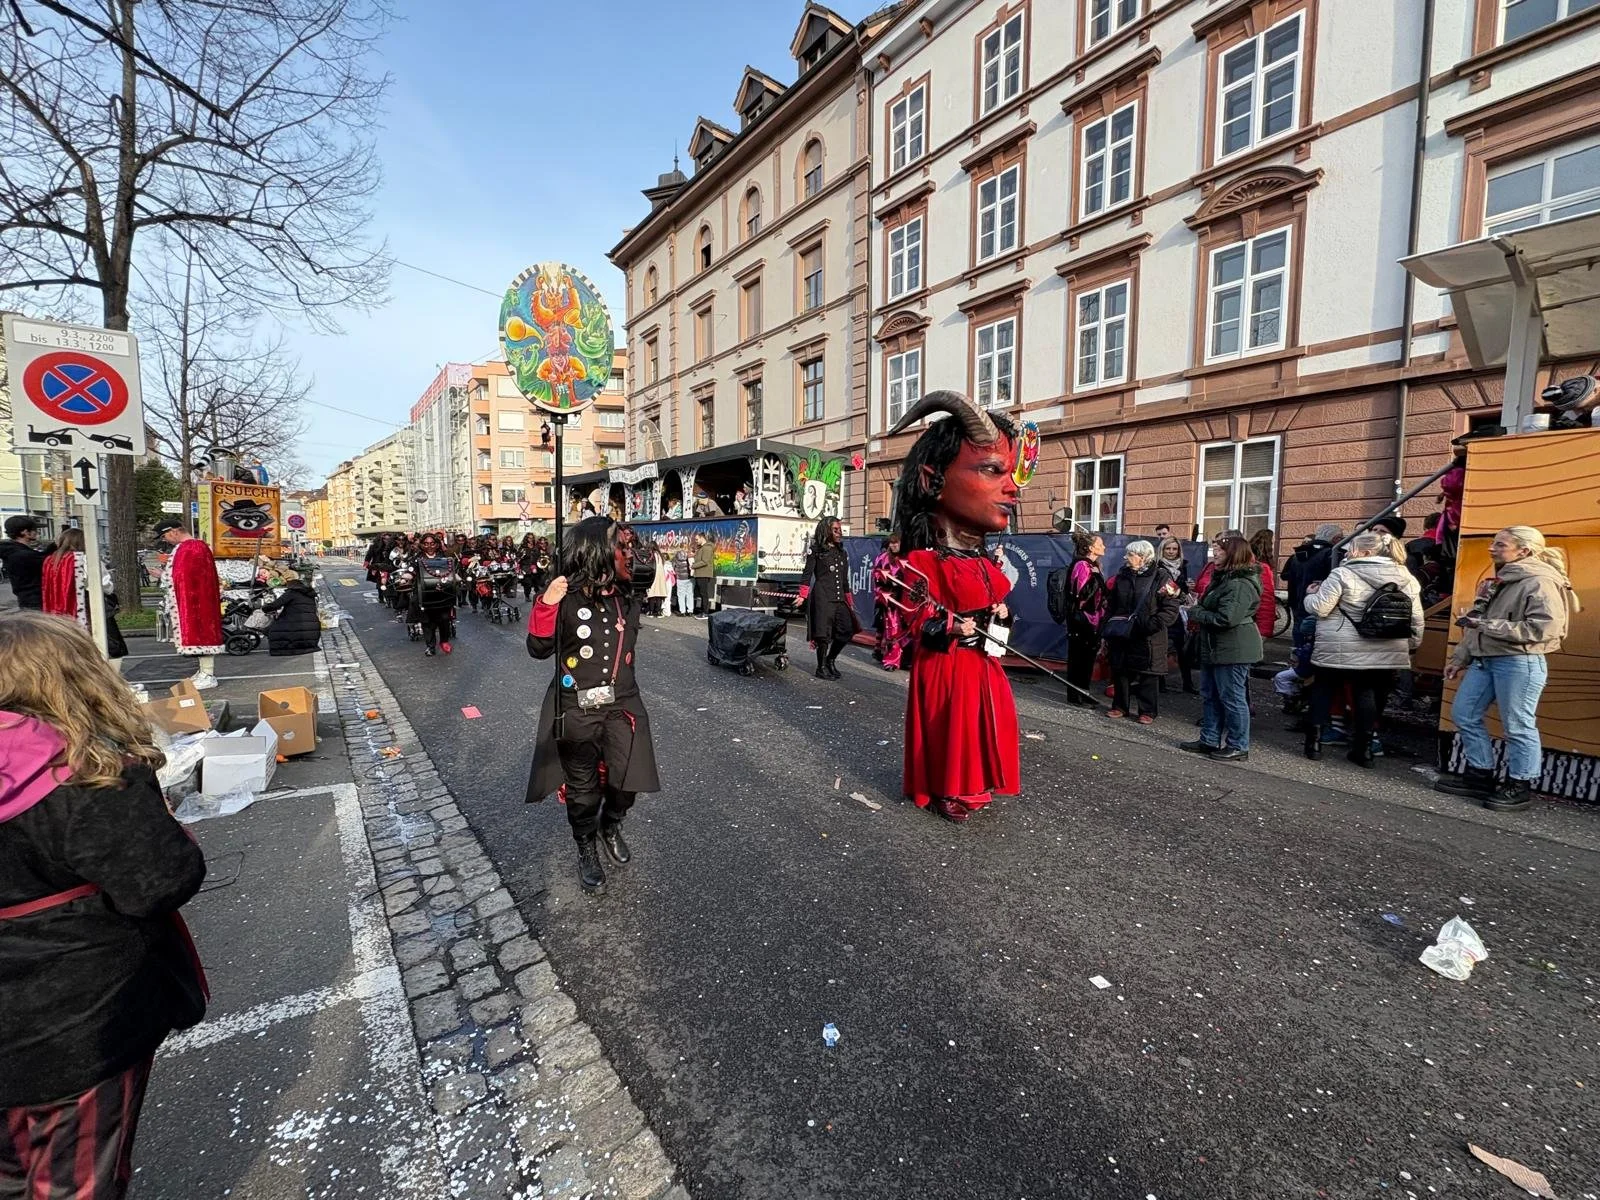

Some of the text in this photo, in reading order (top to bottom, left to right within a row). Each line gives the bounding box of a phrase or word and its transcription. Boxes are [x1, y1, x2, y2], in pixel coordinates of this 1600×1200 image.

[30, 333, 48, 344] bis
[90, 342, 114, 351] 1200
[89, 333, 114, 343] 2200
[213, 484, 278, 499] GSUECHT
